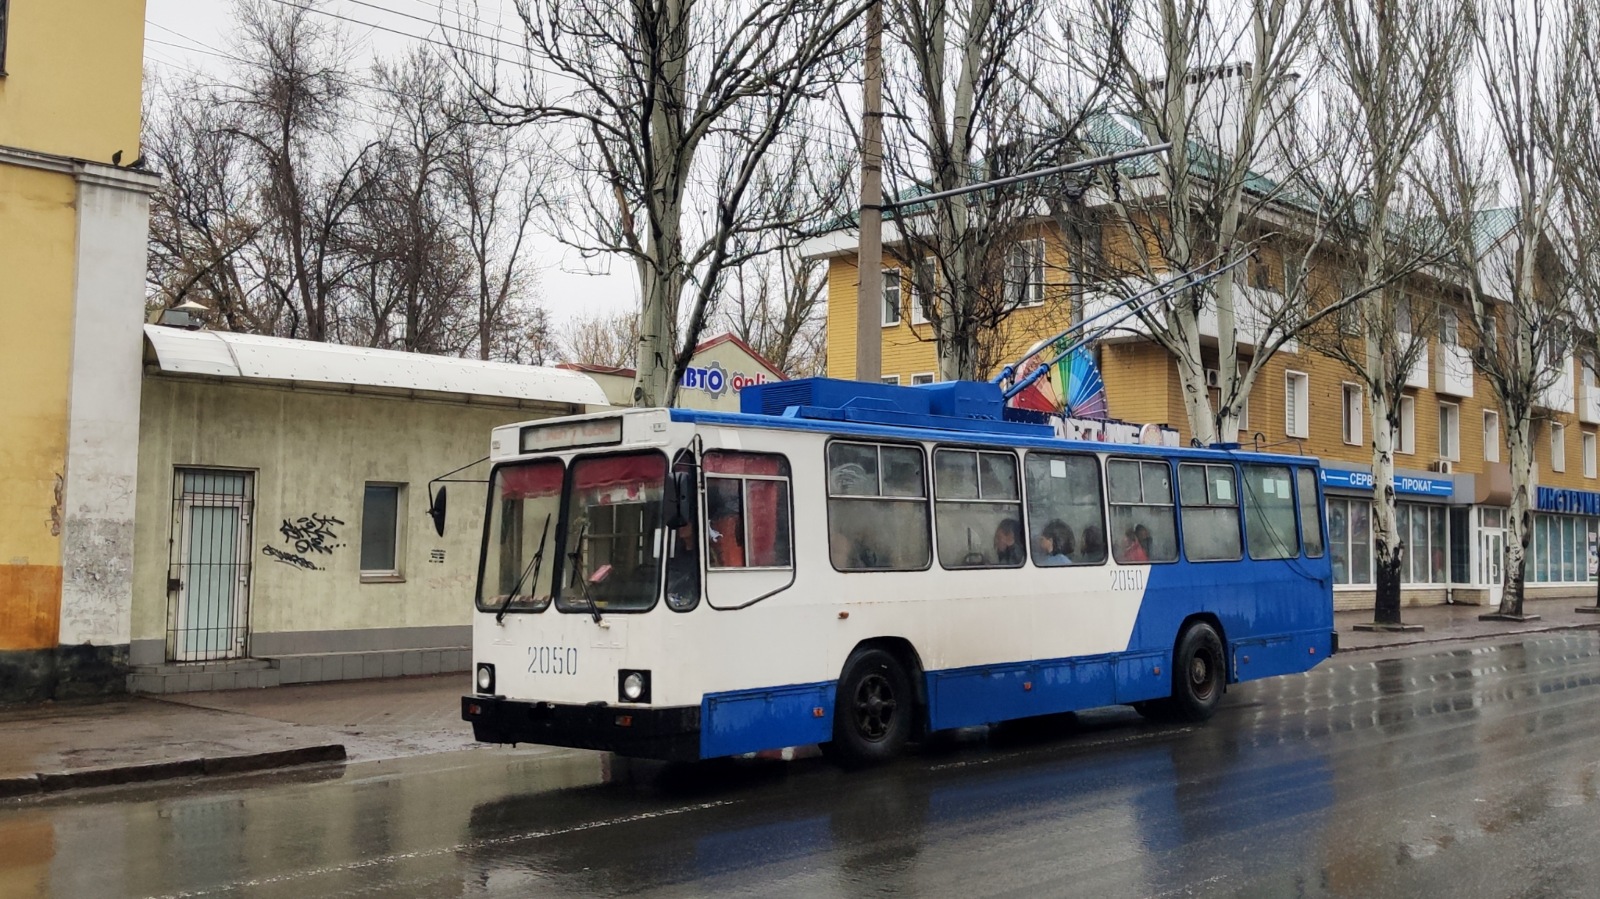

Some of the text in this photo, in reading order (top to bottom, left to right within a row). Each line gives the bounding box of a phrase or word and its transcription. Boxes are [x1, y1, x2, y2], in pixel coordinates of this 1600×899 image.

[733, 373, 775, 391] onli
[1349, 472, 1432, 491] СЕРВ ПРОКАТ
[1110, 569, 1143, 591] 2050
[528, 646, 577, 675] 2050
